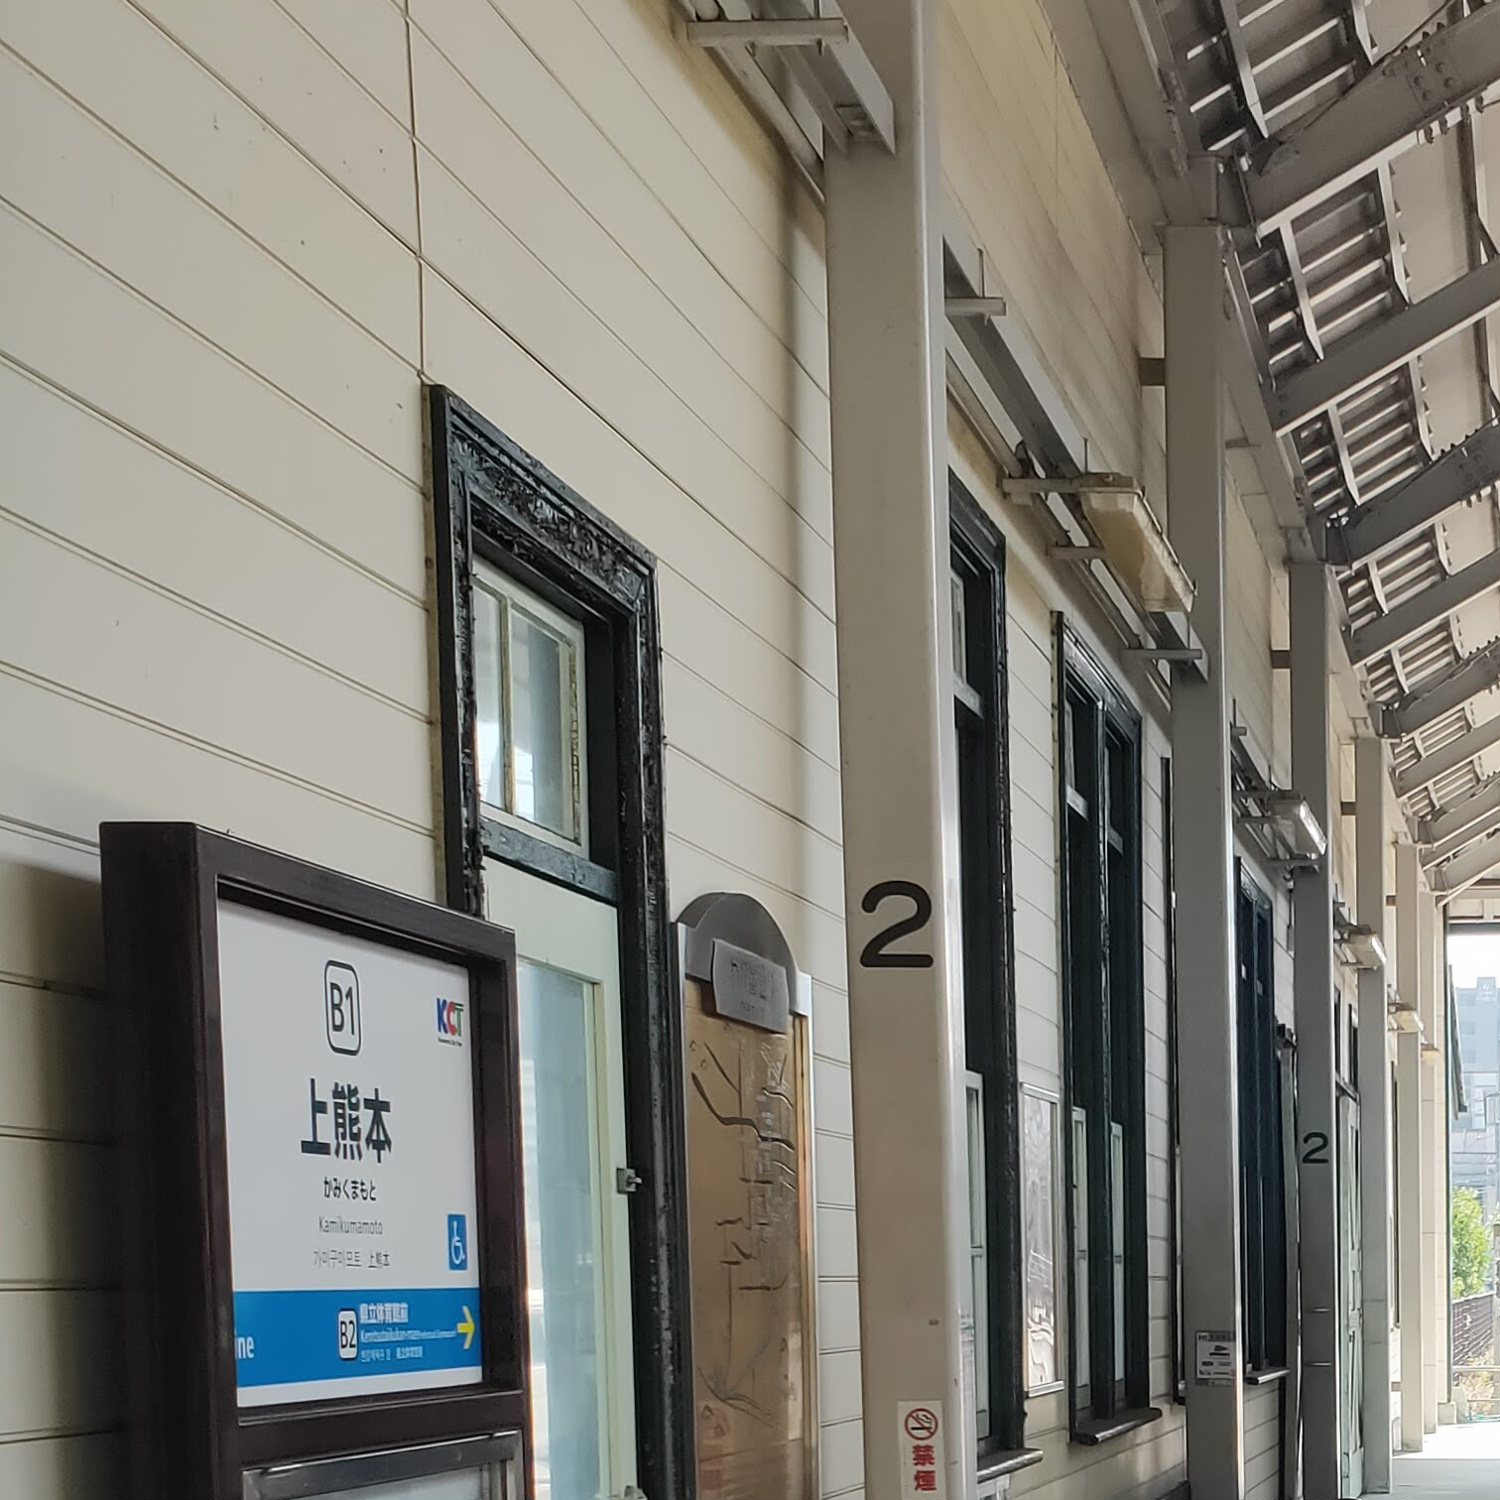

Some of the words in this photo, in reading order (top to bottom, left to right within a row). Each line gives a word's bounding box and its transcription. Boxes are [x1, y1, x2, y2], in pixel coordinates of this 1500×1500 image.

[860, 880, 933, 968] 2
[330, 981, 355, 1036] B1
[437, 997, 464, 1038] KCT
[301, 1078, 392, 1163] 上熊本
[1302, 1131, 1329, 1164] 2
[323, 1176, 377, 1201] かみくまもと
[319, 1216, 383, 1235] Kamikumamoto
[340, 1320, 357, 1349] B2
[912, 1444, 937, 1491] 禁煙
